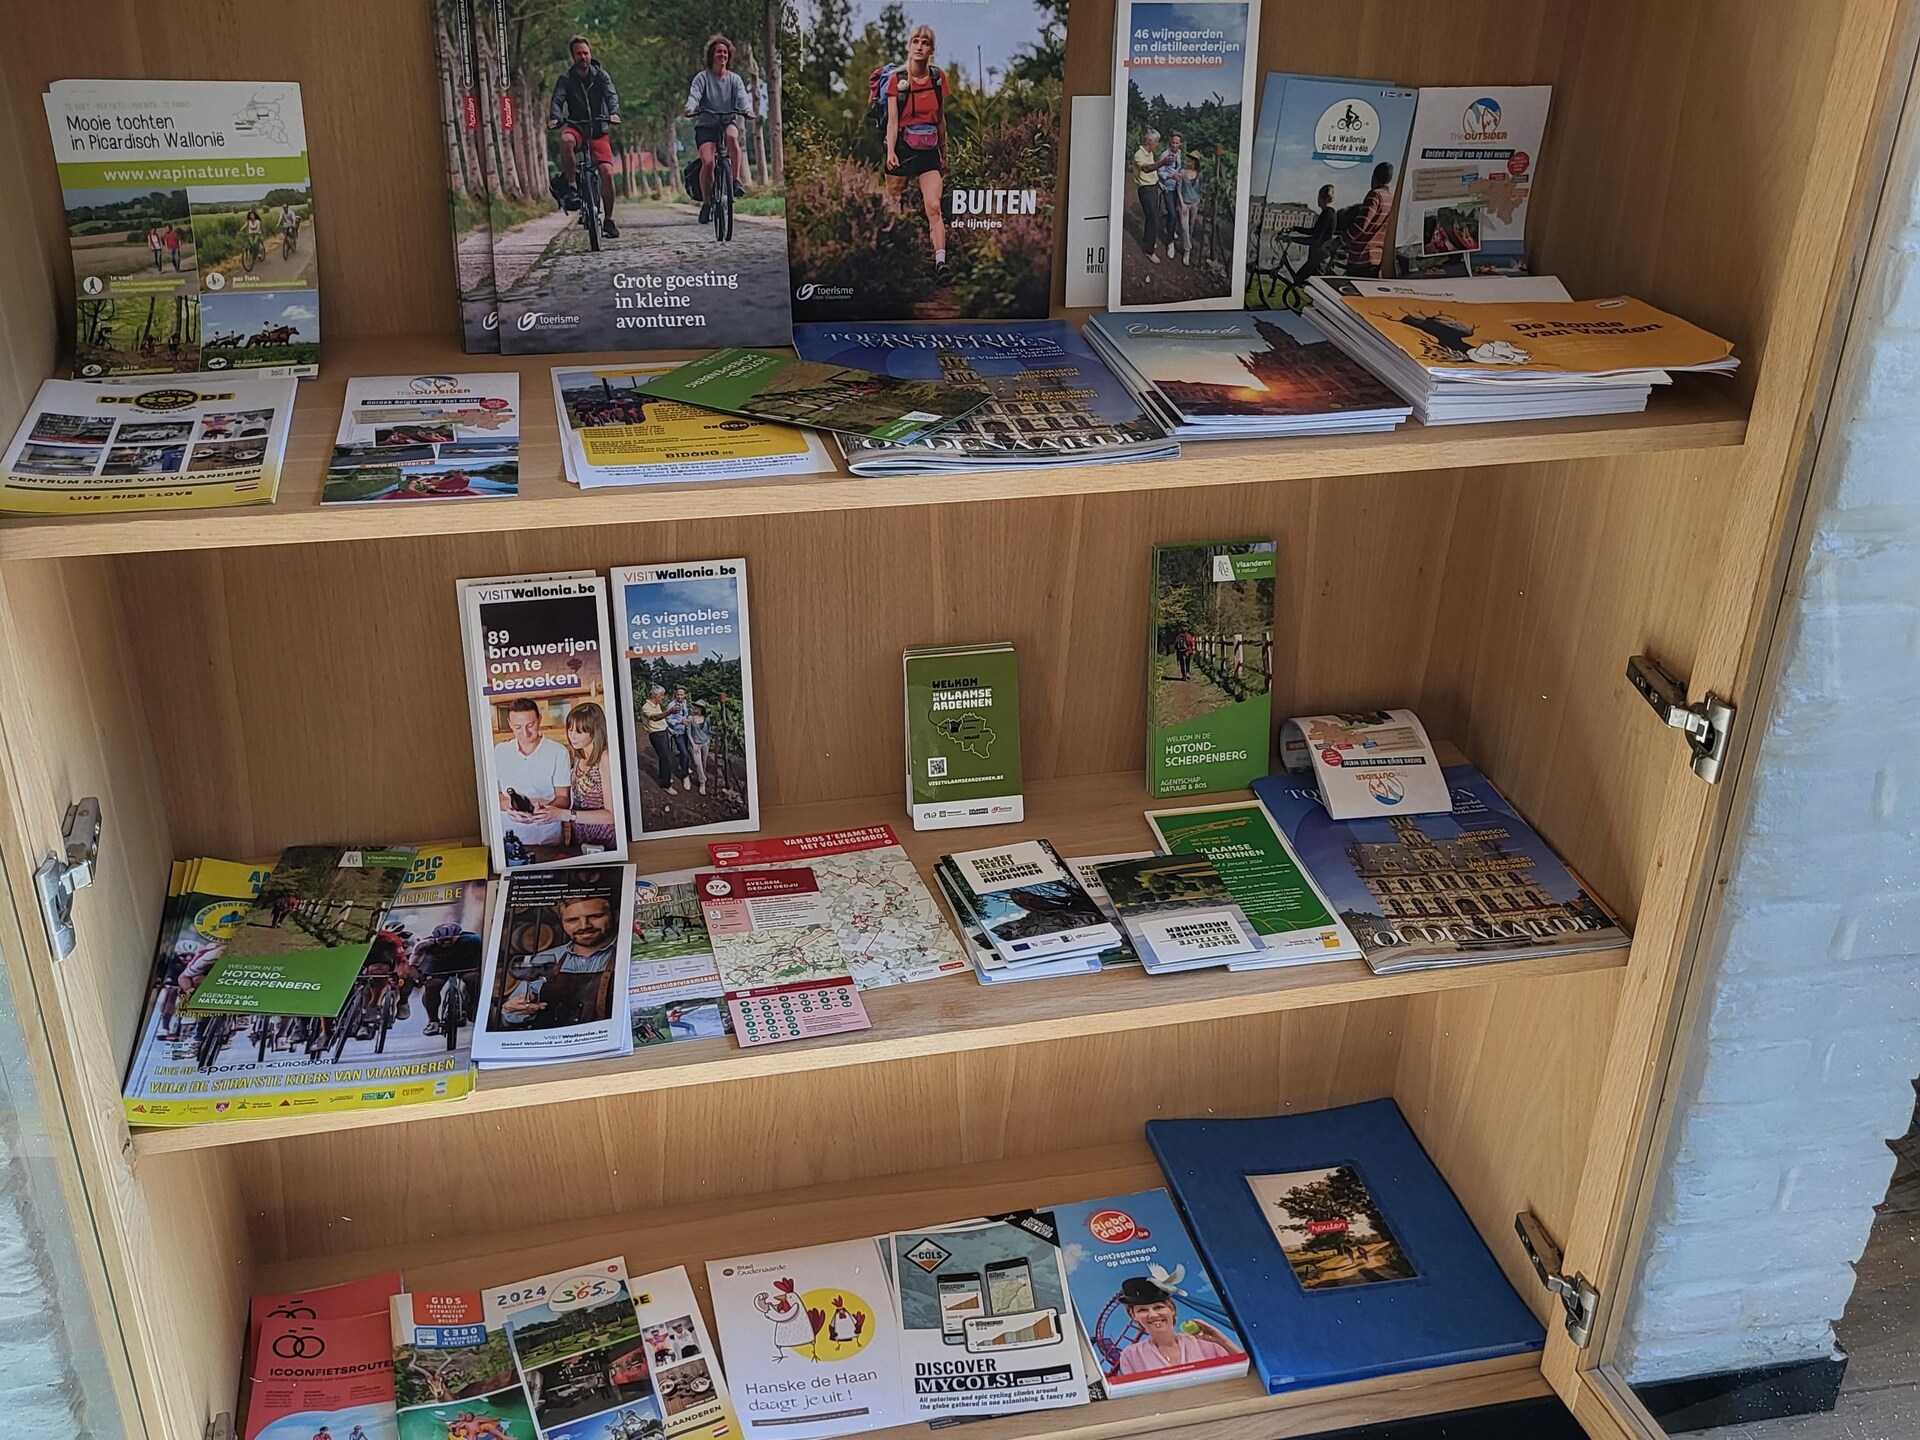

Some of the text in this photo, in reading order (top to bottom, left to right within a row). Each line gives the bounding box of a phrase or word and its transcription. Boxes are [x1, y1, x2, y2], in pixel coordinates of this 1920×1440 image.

[1134, 28, 1223, 41] 46 wijngaarden
[1134, 41, 1239, 54] en distilleerderijen
[1133, 54, 1222, 65] om te bezoeken
[66, 114, 174, 131] Mooie tochten
[71, 132, 225, 150] in Picardisch Wallonië
[1328, 134, 1366, 144] La Wallonie
[1322, 143, 1346, 152] picarde
[104, 162, 265, 185] www.wapinature.be
[952, 189, 1037, 215] BUITEN
[951, 218, 1002, 230] de lijntjes
[613, 270, 738, 291] Grote goesting
[615, 292, 690, 309] in kleine
[540, 314, 580, 324] toerisme
[616, 314, 706, 329] avonturen
[1511, 320, 1625, 331] De Ronde
[1125, 322, 1241, 336] Oudenaarde
[1523, 322, 1664, 339] van Varken
[862, 431, 1152, 450] ODENAARDE
[8, 468, 262, 485] CENTRUM RONDE VAN VLAANDEREN
[156, 490, 193, 498] LOVE
[1235, 559, 1272, 569] Vlaanderen
[623, 566, 736, 582] VISITWallonia.be
[478, 584, 595, 601] VISITWallonia.be
[631, 609, 729, 627] 46 vignobles
[487, 630, 510, 645] 89
[632, 622, 732, 641] et distilleries
[489, 638, 597, 660] brouwerijen
[633, 639, 697, 655] à visiter
[490, 658, 541, 675] om te
[492, 672, 578, 692] bezoeken
[932, 677, 979, 689] WELKOM
[940, 688, 992, 701] VLAAMSE
[933, 698, 993, 711] ARDENNEN
[1166, 733, 1193, 743] WELKOM
[1202, 732, 1211, 740] DE
[1165, 741, 1216, 755] HOTOND-
[1165, 750, 1247, 767] SCHERPENBERG
[1160, 776, 1201, 786] AGENTSCHAP
[1160, 782, 1207, 793] NATUUR BOS
[783, 837, 803, 846] VAN
[804, 835, 825, 844] BOS
[867, 827, 885, 835] TOT
[800, 832, 889, 851] HET VOLKEGEMBOS
[1195, 843, 1252, 854] VLAAMSE
[1204, 849, 1265, 861] RDENNEN
[409, 856, 443, 872] PIC
[986, 863, 1040, 878] VLAAMSE
[404, 870, 436, 883] 025
[983, 868, 1043, 884] ARDENNEN
[1372, 915, 1602, 948] OUDENAARDE
[222, 969, 286, 980] HOTOND-
[216, 978, 321, 991] SCHERPENBERG
[201, 992, 254, 1000] AGENTSCHAP
[150, 1081, 187, 1093] VOLG
[189, 1080, 210, 1093] DE
[334, 1070, 363, 1081] VAN
[366, 1058, 456, 1079] VLAANDEREN
[918, 1251, 942, 1260] COLS
[1093, 1245, 1157, 1263] (ont)spannend
[1107, 1253, 1151, 1268] op uitstap
[431, 1296, 462, 1304] GIDS
[497, 1285, 547, 1306] 2024
[269, 1360, 394, 1377] ICOONFIETSROUTE
[915, 1359, 996, 1376] DISCOVER
[745, 1370, 877, 1395] Hanske de Haan
[917, 1373, 1015, 1393] MYCOLS!
[748, 1390, 845, 1413] daagt je uit
[920, 1402, 930, 1410] the
[932, 1401, 950, 1411] globe
[951, 1400, 979, 1409] gathered
[1002, 1395, 1038, 1406] astonishing
[1046, 1393, 1064, 1402] fancy
[1065, 1391, 1077, 1399] app
[929, 1395, 959, 1403] notorious
[961, 1393, 973, 1401] and
[974, 1392, 988, 1401] epic
[989, 1390, 1012, 1401] cycling
[1013, 1388, 1034, 1397] climbs
[1035, 1386, 1058, 1395] around
